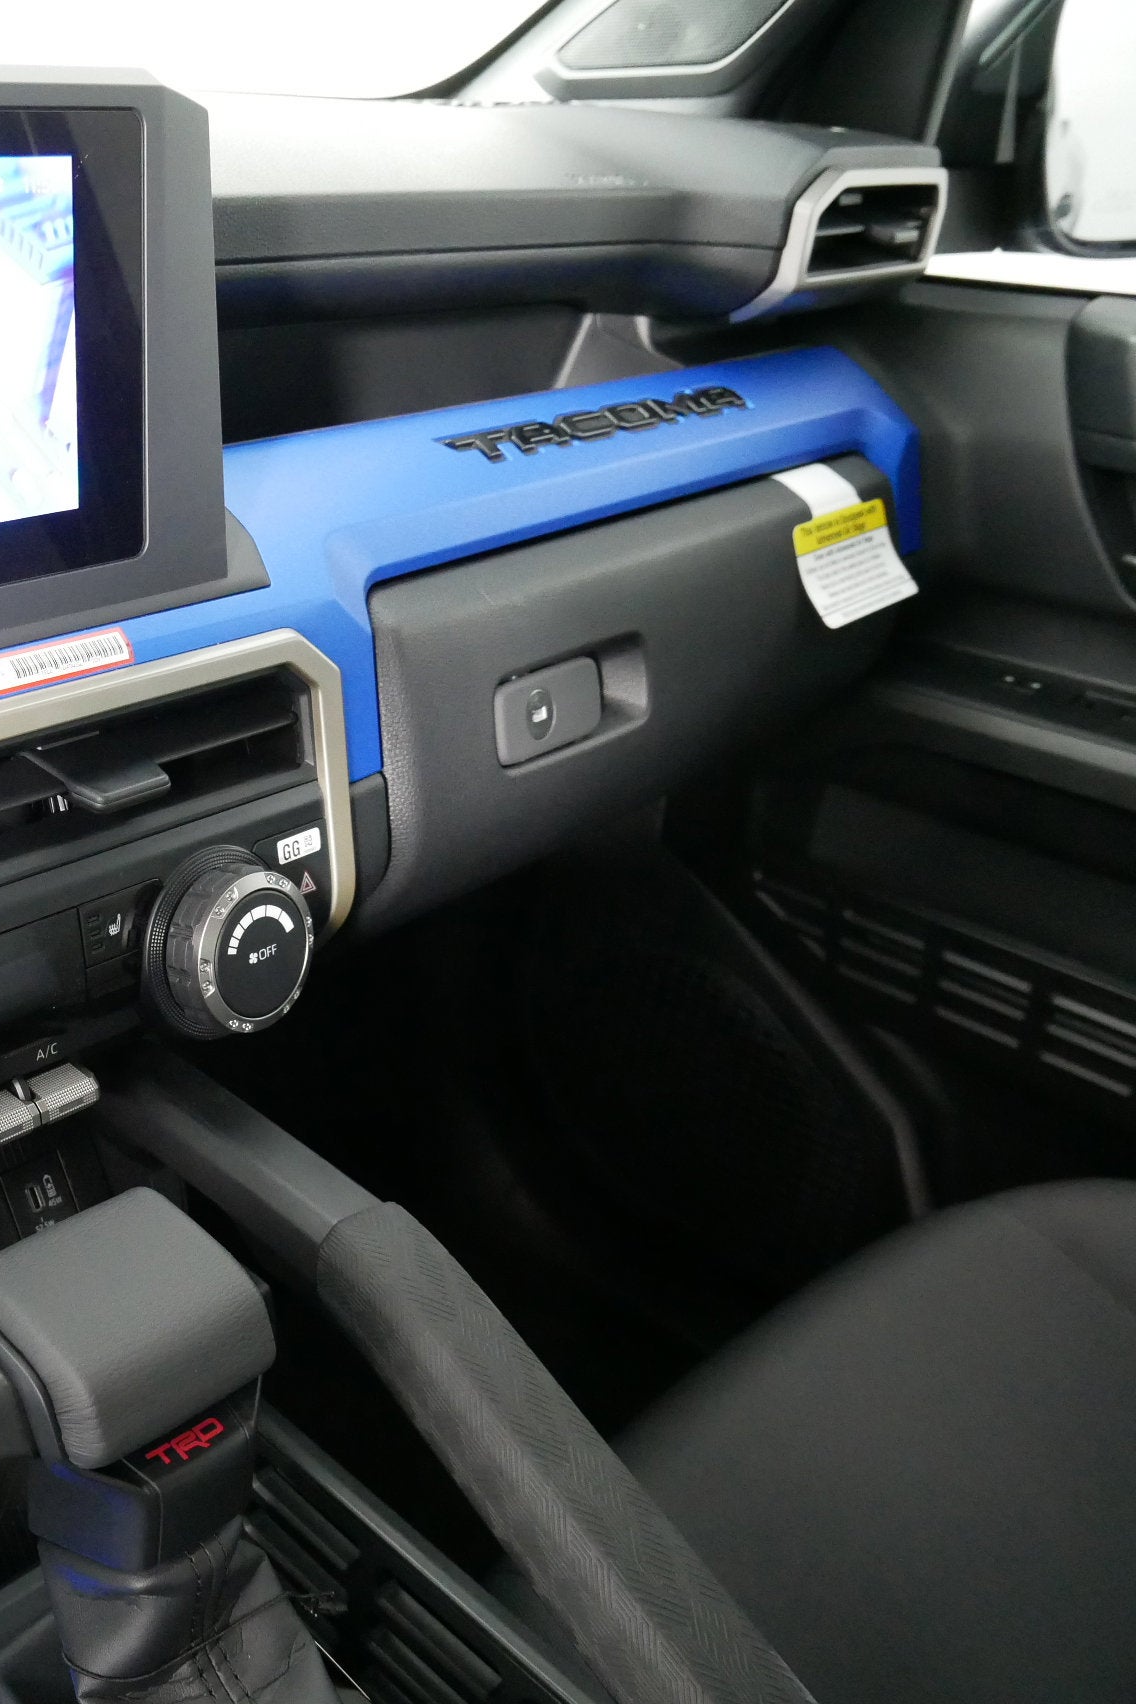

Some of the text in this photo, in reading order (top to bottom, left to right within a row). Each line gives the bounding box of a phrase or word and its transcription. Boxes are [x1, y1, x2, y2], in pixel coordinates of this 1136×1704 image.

[434, 385, 748, 464] TACOMA
[283, 840, 301, 861] GG
[258, 943, 278, 961] OFF
[36, 1042, 59, 1062] A/C
[145, 1417, 225, 1465] TRD
